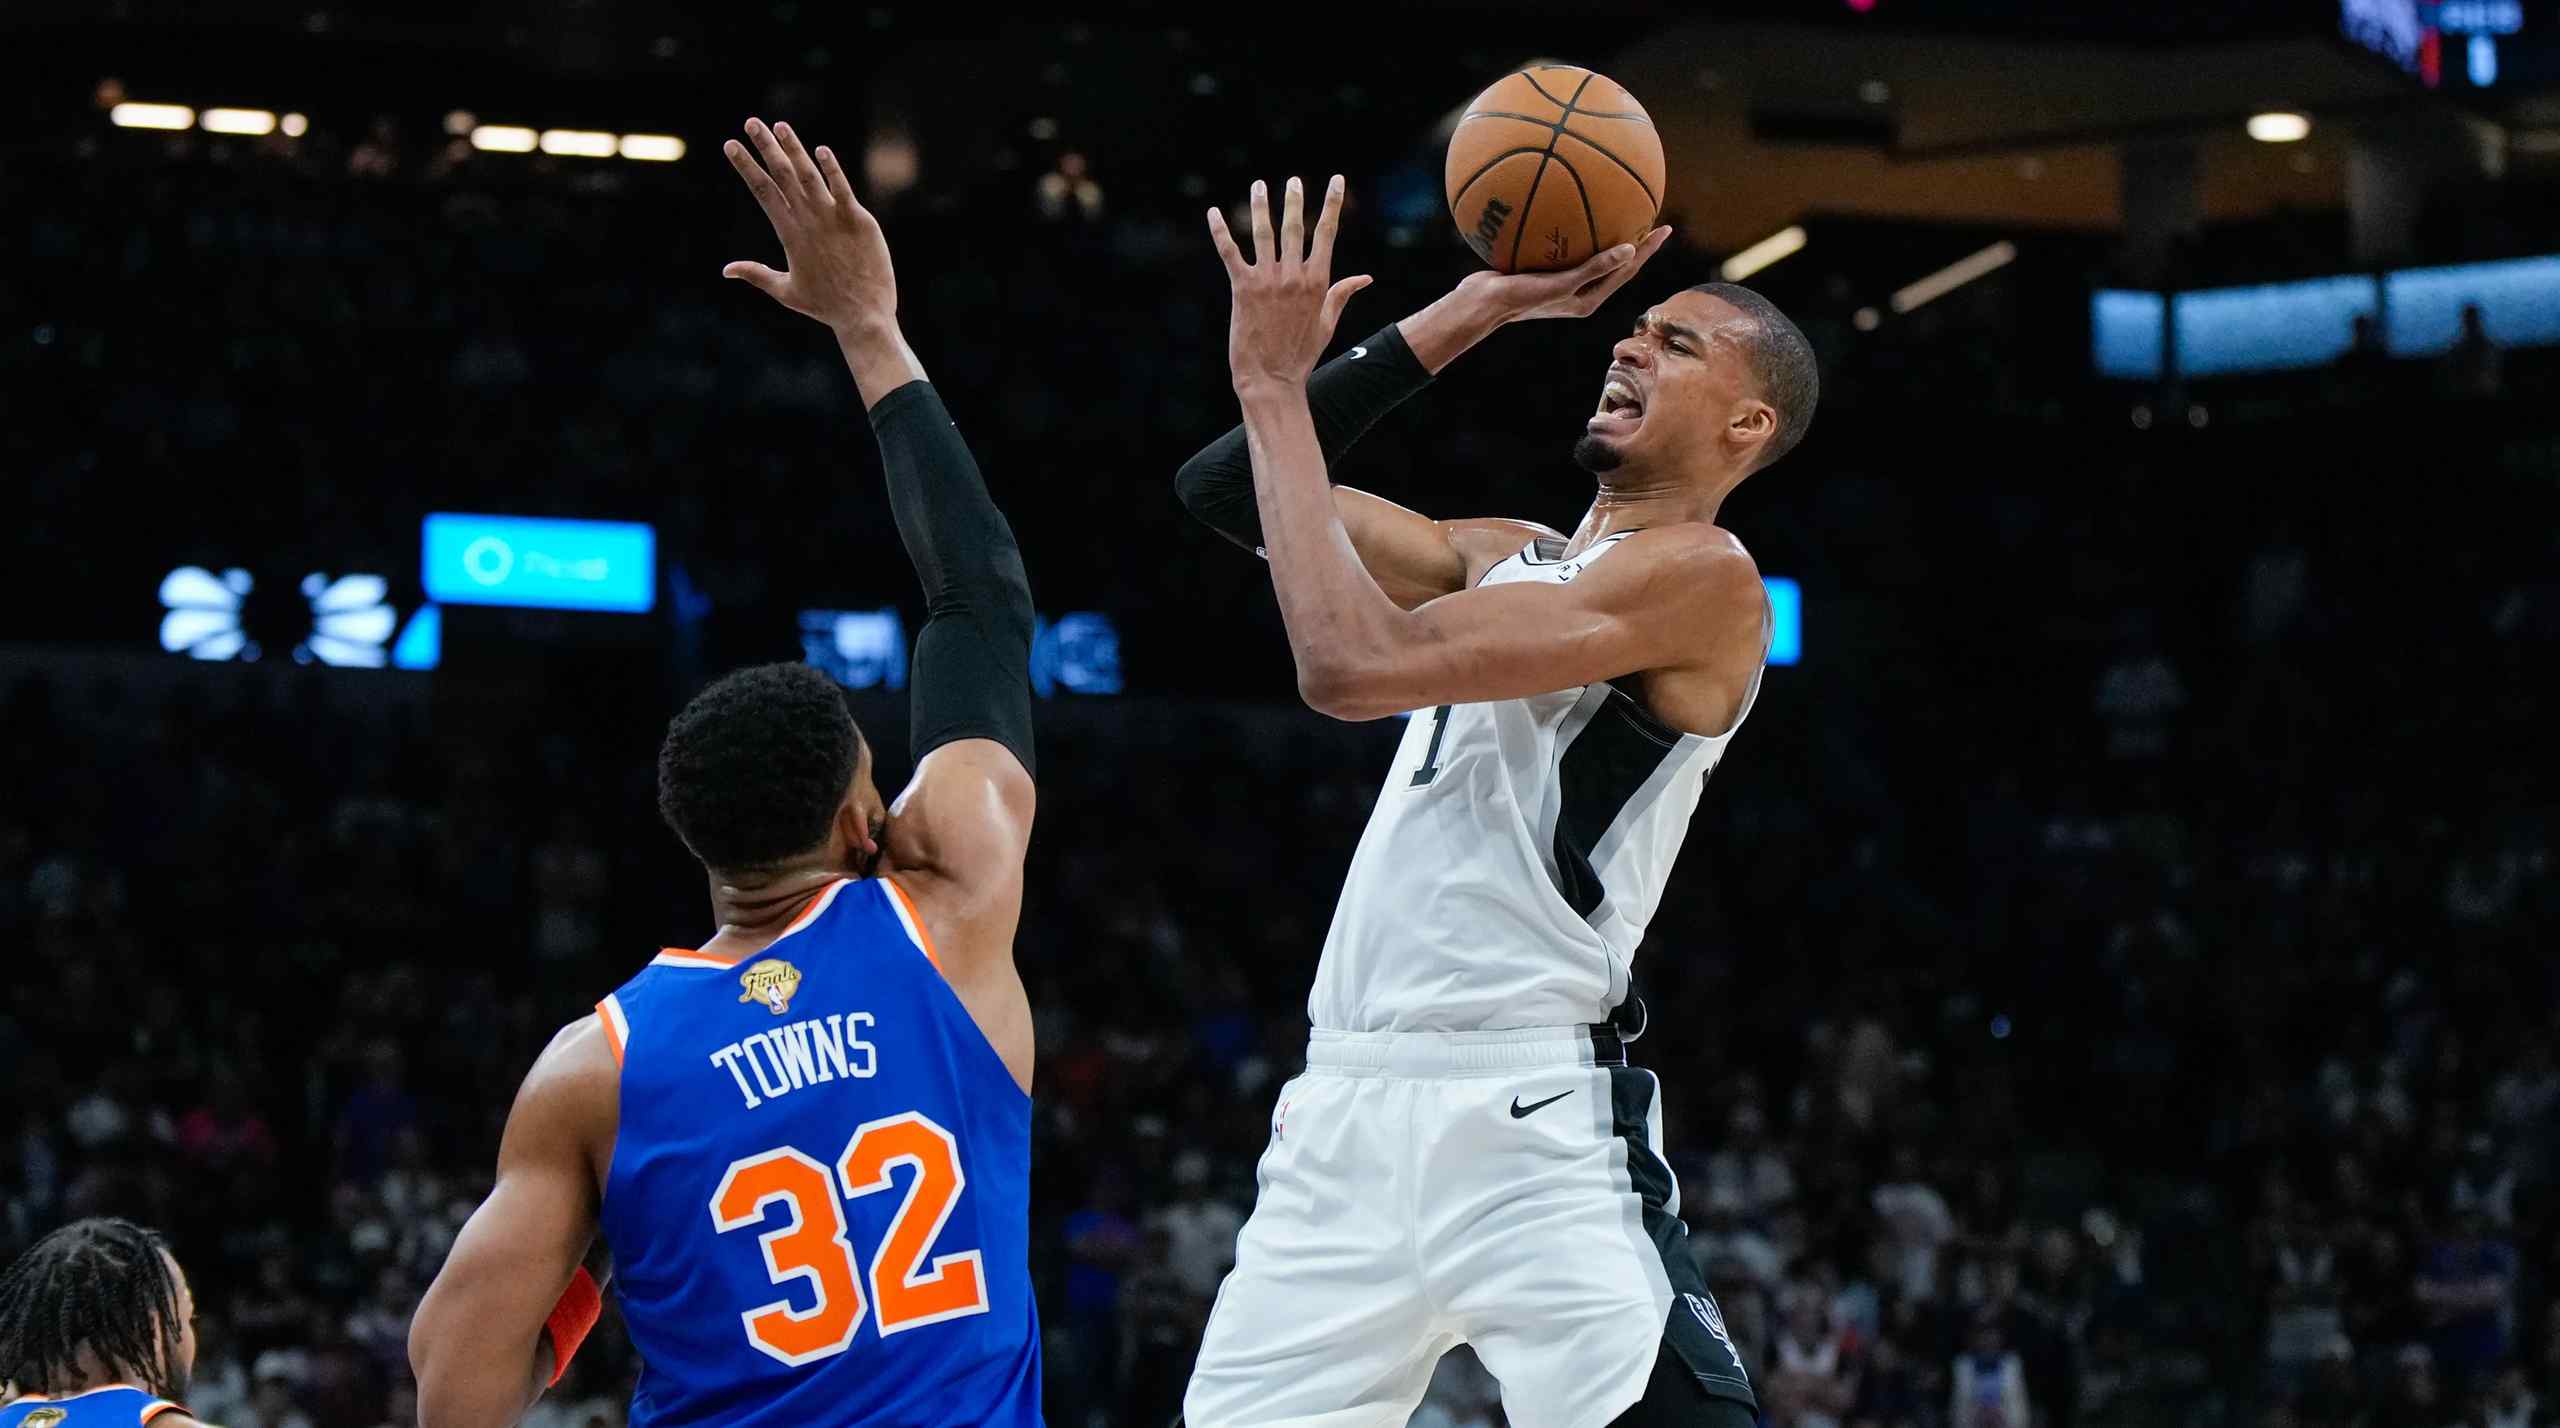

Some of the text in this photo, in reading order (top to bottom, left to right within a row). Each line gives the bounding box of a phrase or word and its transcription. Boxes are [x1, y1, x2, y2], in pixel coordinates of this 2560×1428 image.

[1404, 704, 1453, 790] 1
[709, 1012, 877, 1109] TOWNS
[709, 1110, 989, 1367] 32
